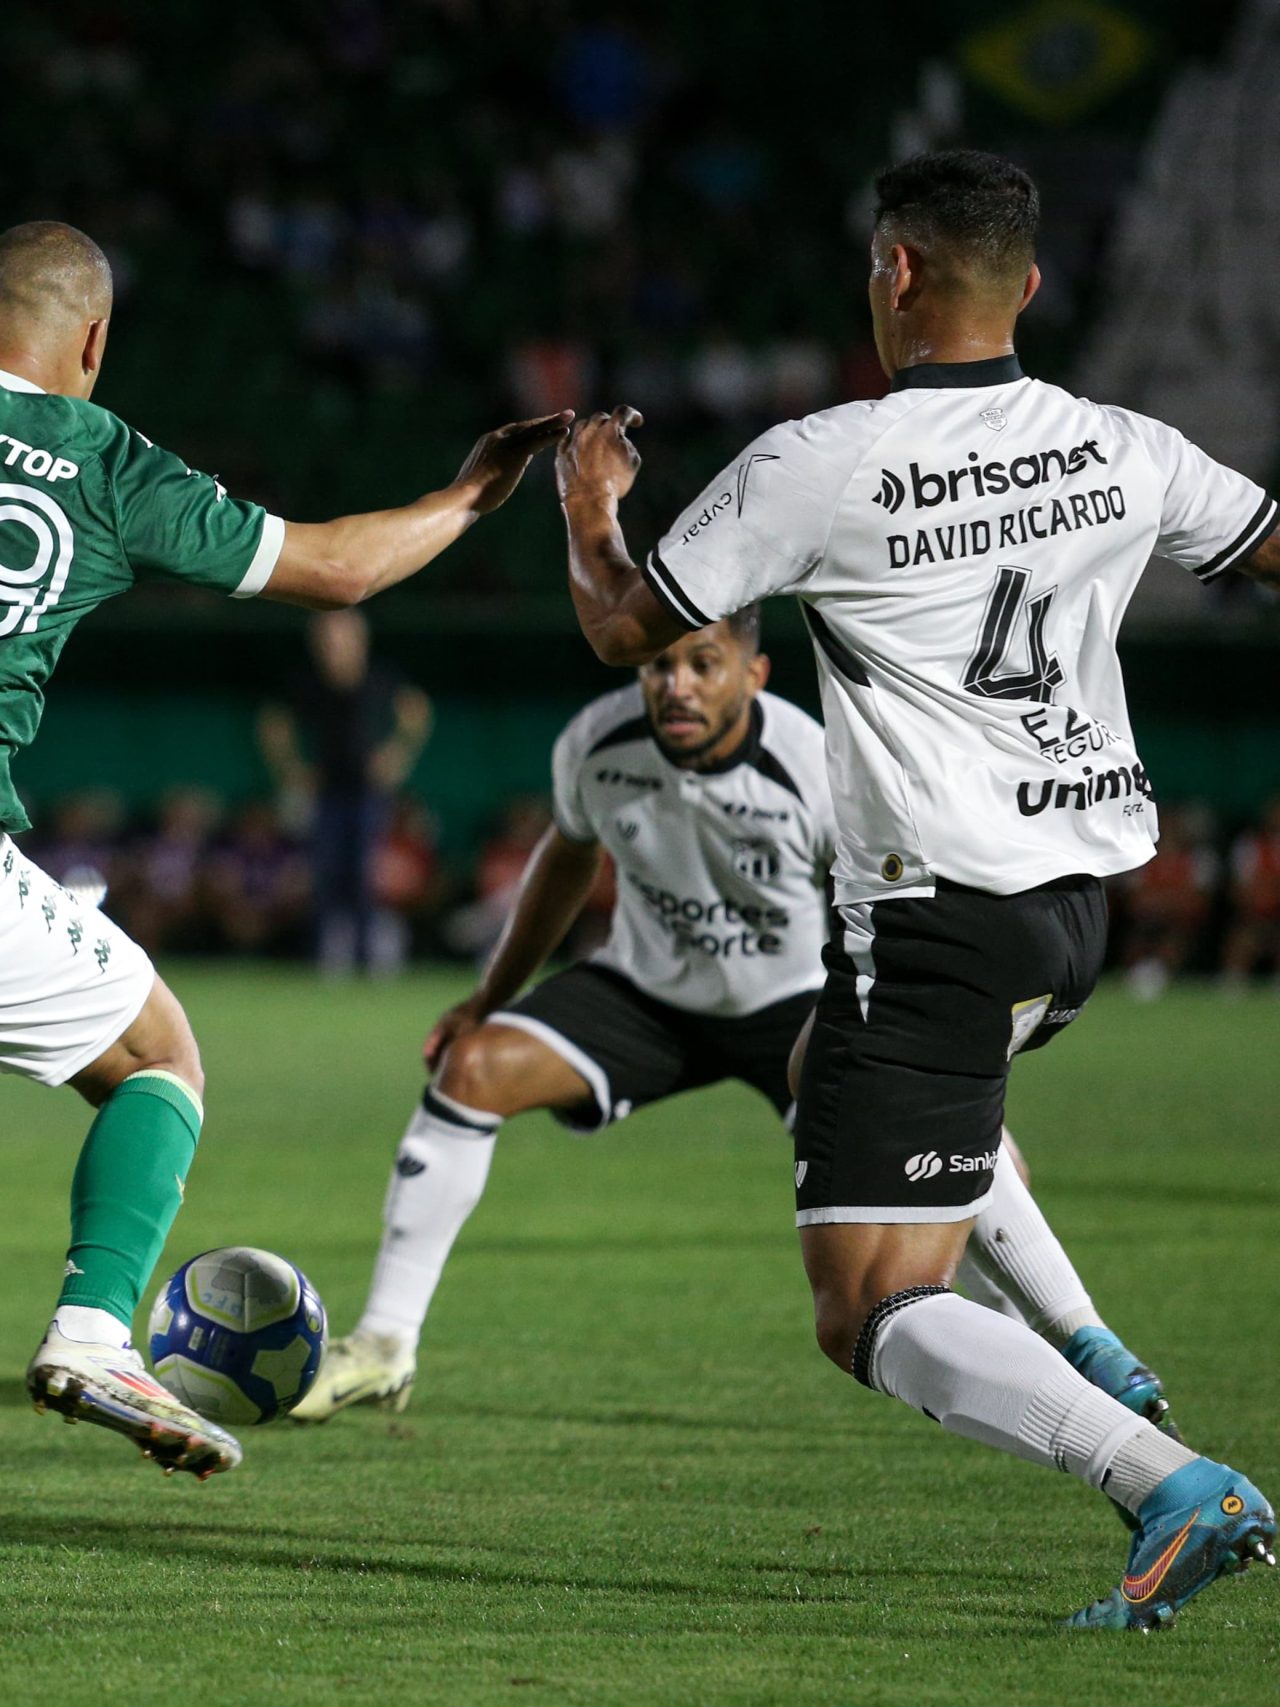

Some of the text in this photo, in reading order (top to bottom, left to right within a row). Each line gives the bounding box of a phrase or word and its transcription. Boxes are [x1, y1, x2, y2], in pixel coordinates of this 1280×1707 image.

[911, 439, 1108, 510] brisanet
[682, 492, 732, 546] cvpar
[888, 485, 1126, 570] DAVID RICARDO
[961, 564, 1066, 704] 4
[1040, 724, 1121, 764] SEGUR
